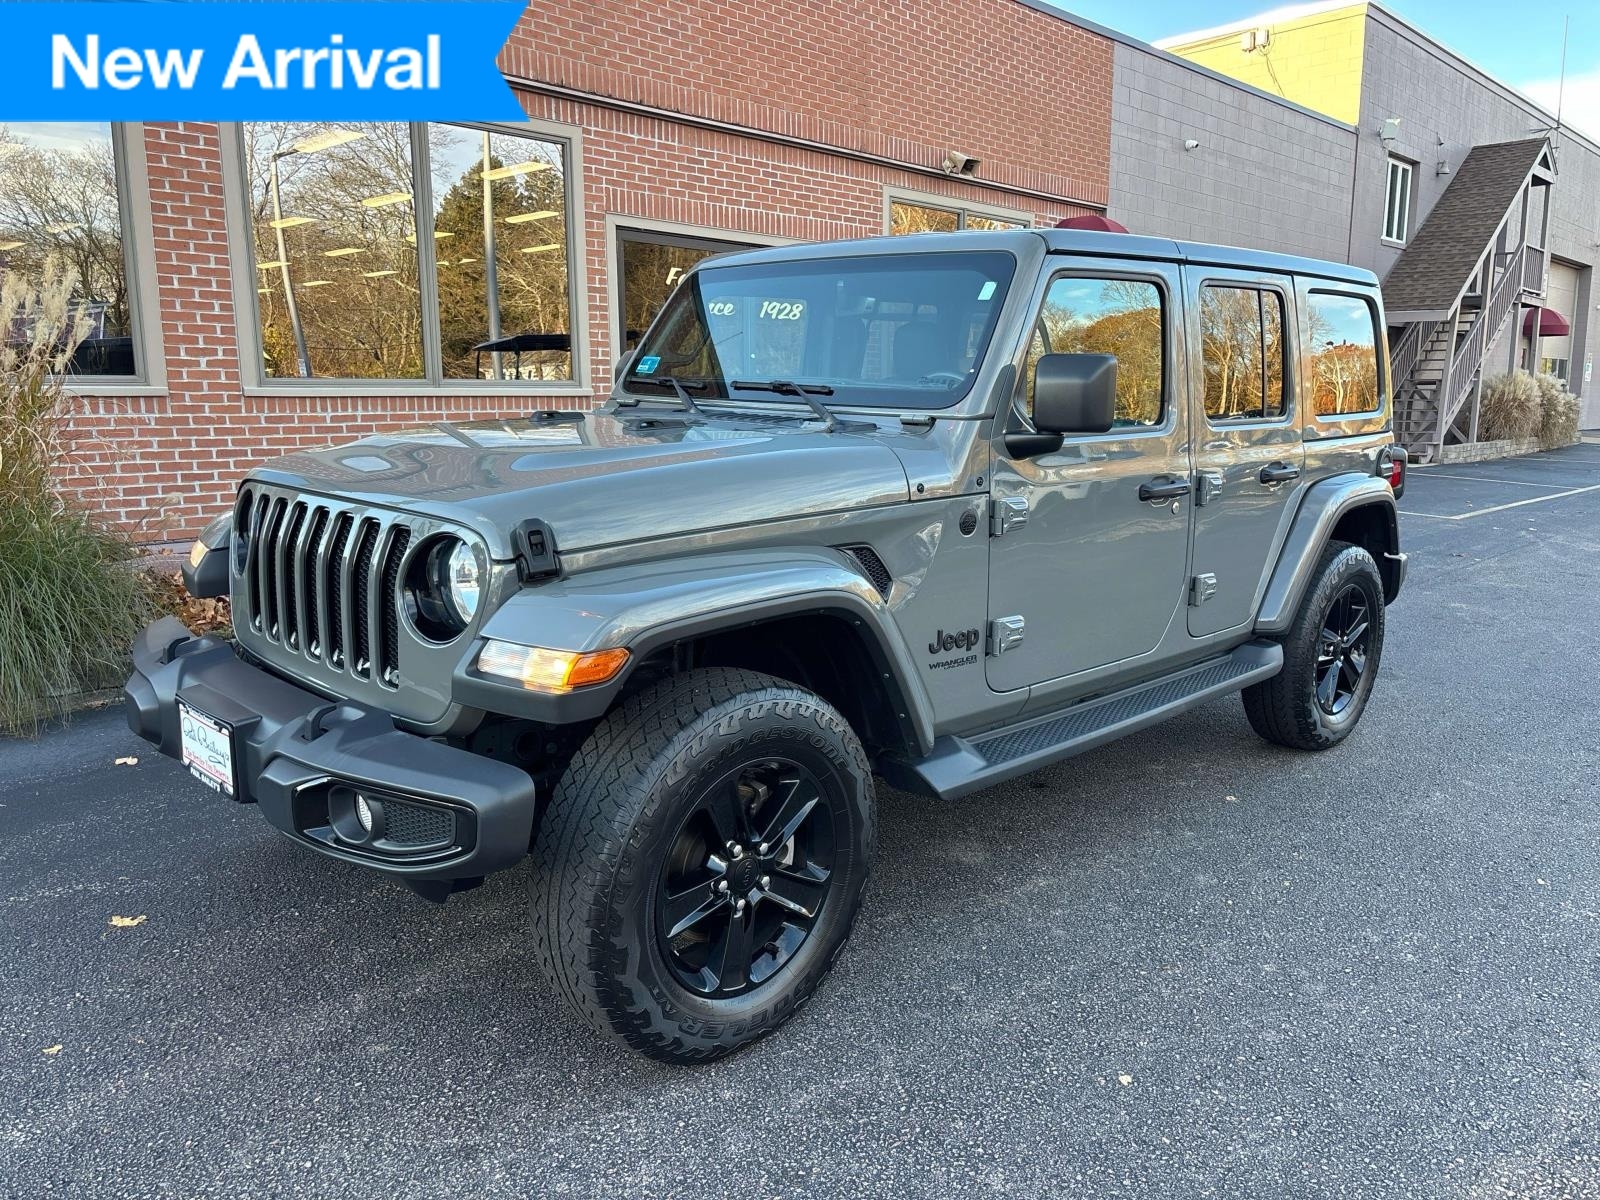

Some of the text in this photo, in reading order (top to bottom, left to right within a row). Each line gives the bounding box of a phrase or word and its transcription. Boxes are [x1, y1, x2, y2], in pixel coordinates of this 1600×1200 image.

[760, 301, 803, 320] 1928
[928, 628, 980, 655] Jeep
[929, 654, 978, 670] WRANGLER
